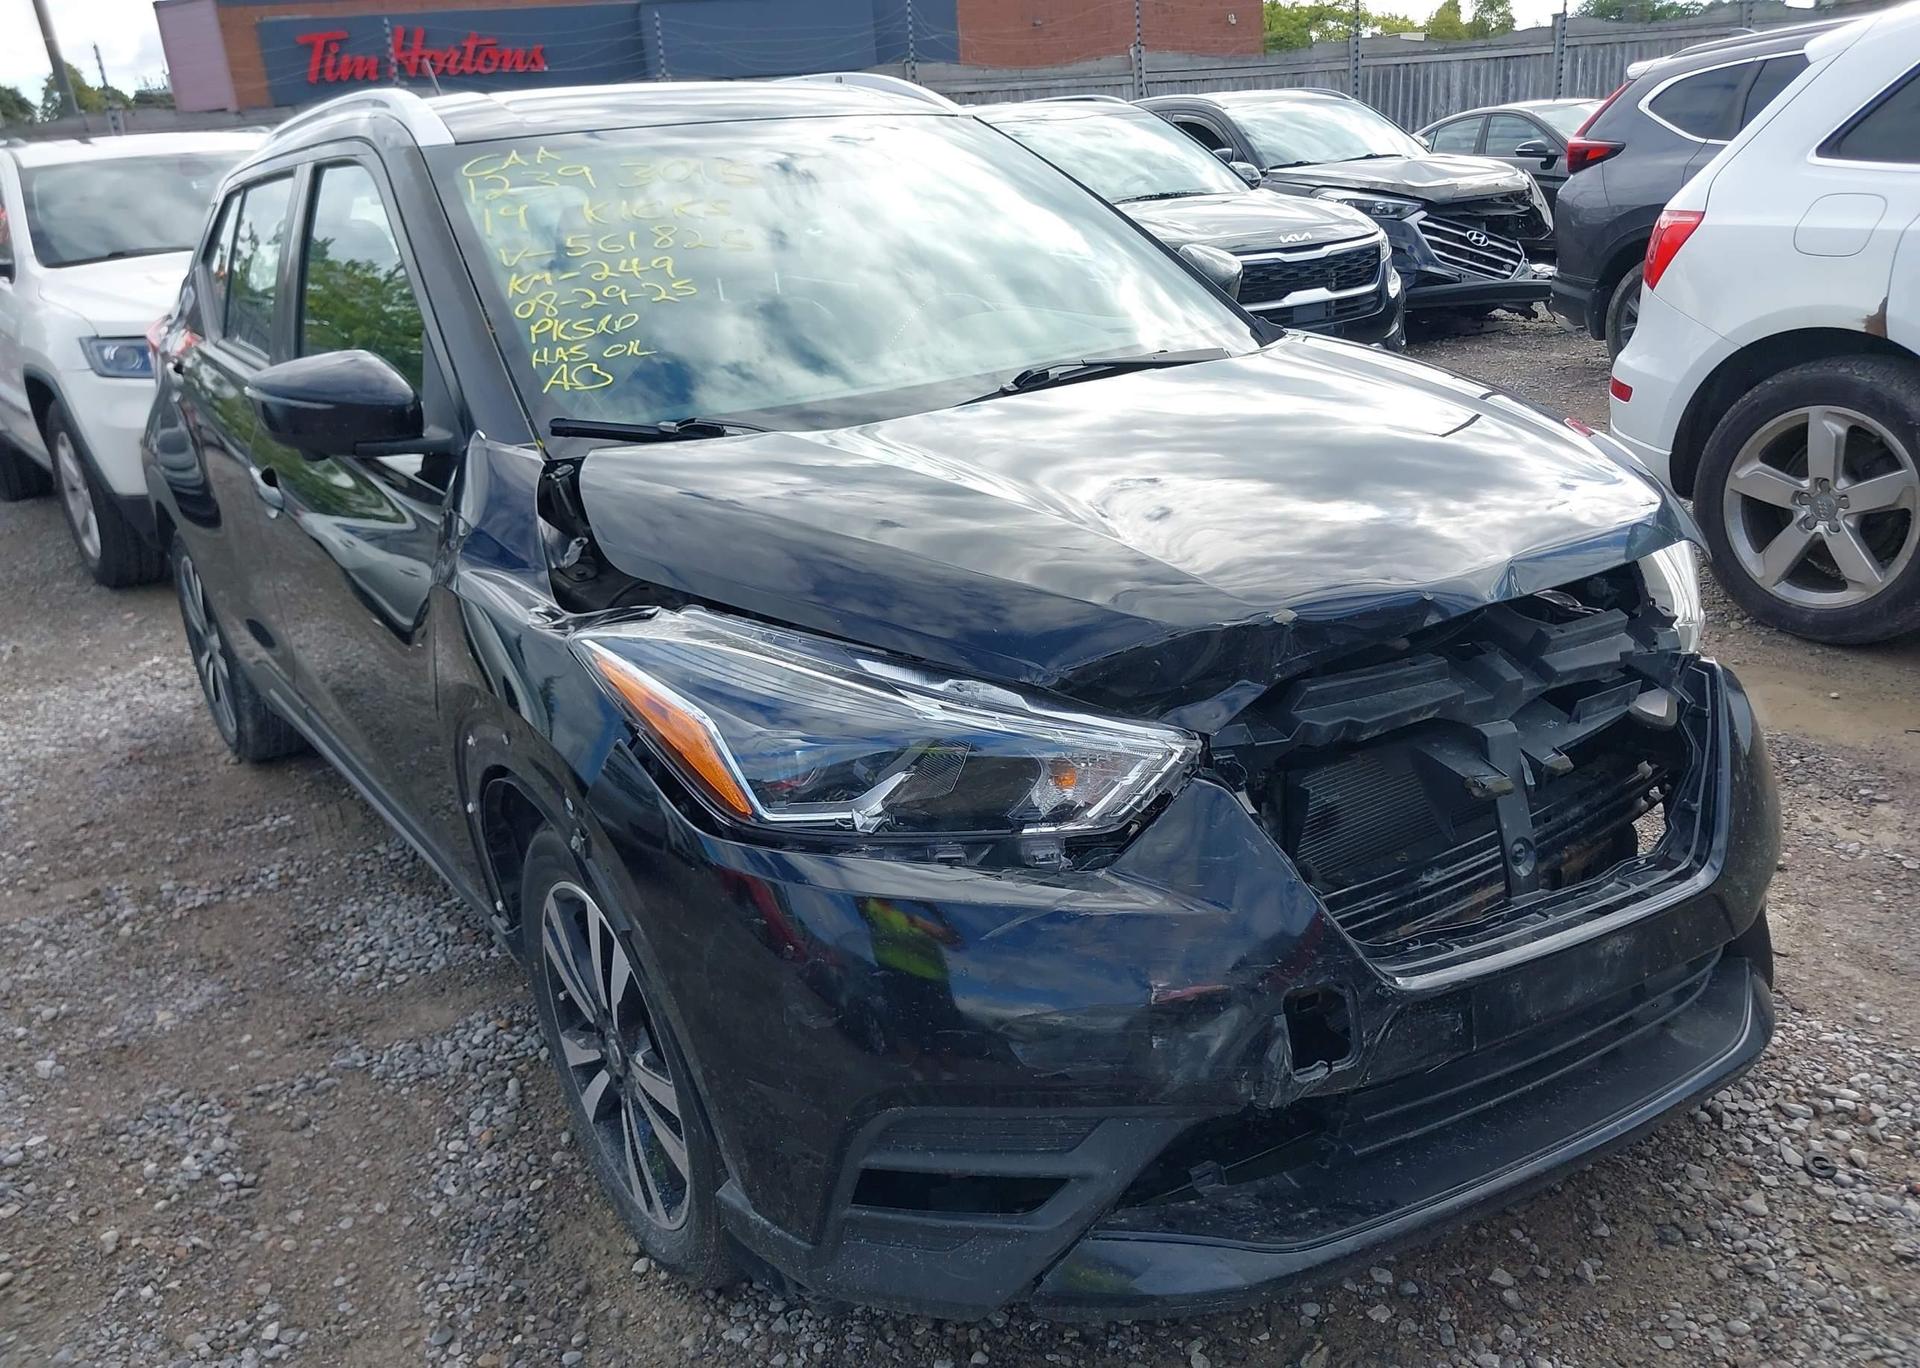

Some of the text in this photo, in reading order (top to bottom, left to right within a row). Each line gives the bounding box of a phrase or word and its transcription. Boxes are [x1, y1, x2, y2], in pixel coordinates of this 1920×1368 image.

[295, 26, 548, 84] Tim Hortons
[462, 147, 561, 177] CAA
[532, 346, 590, 369] HAS
